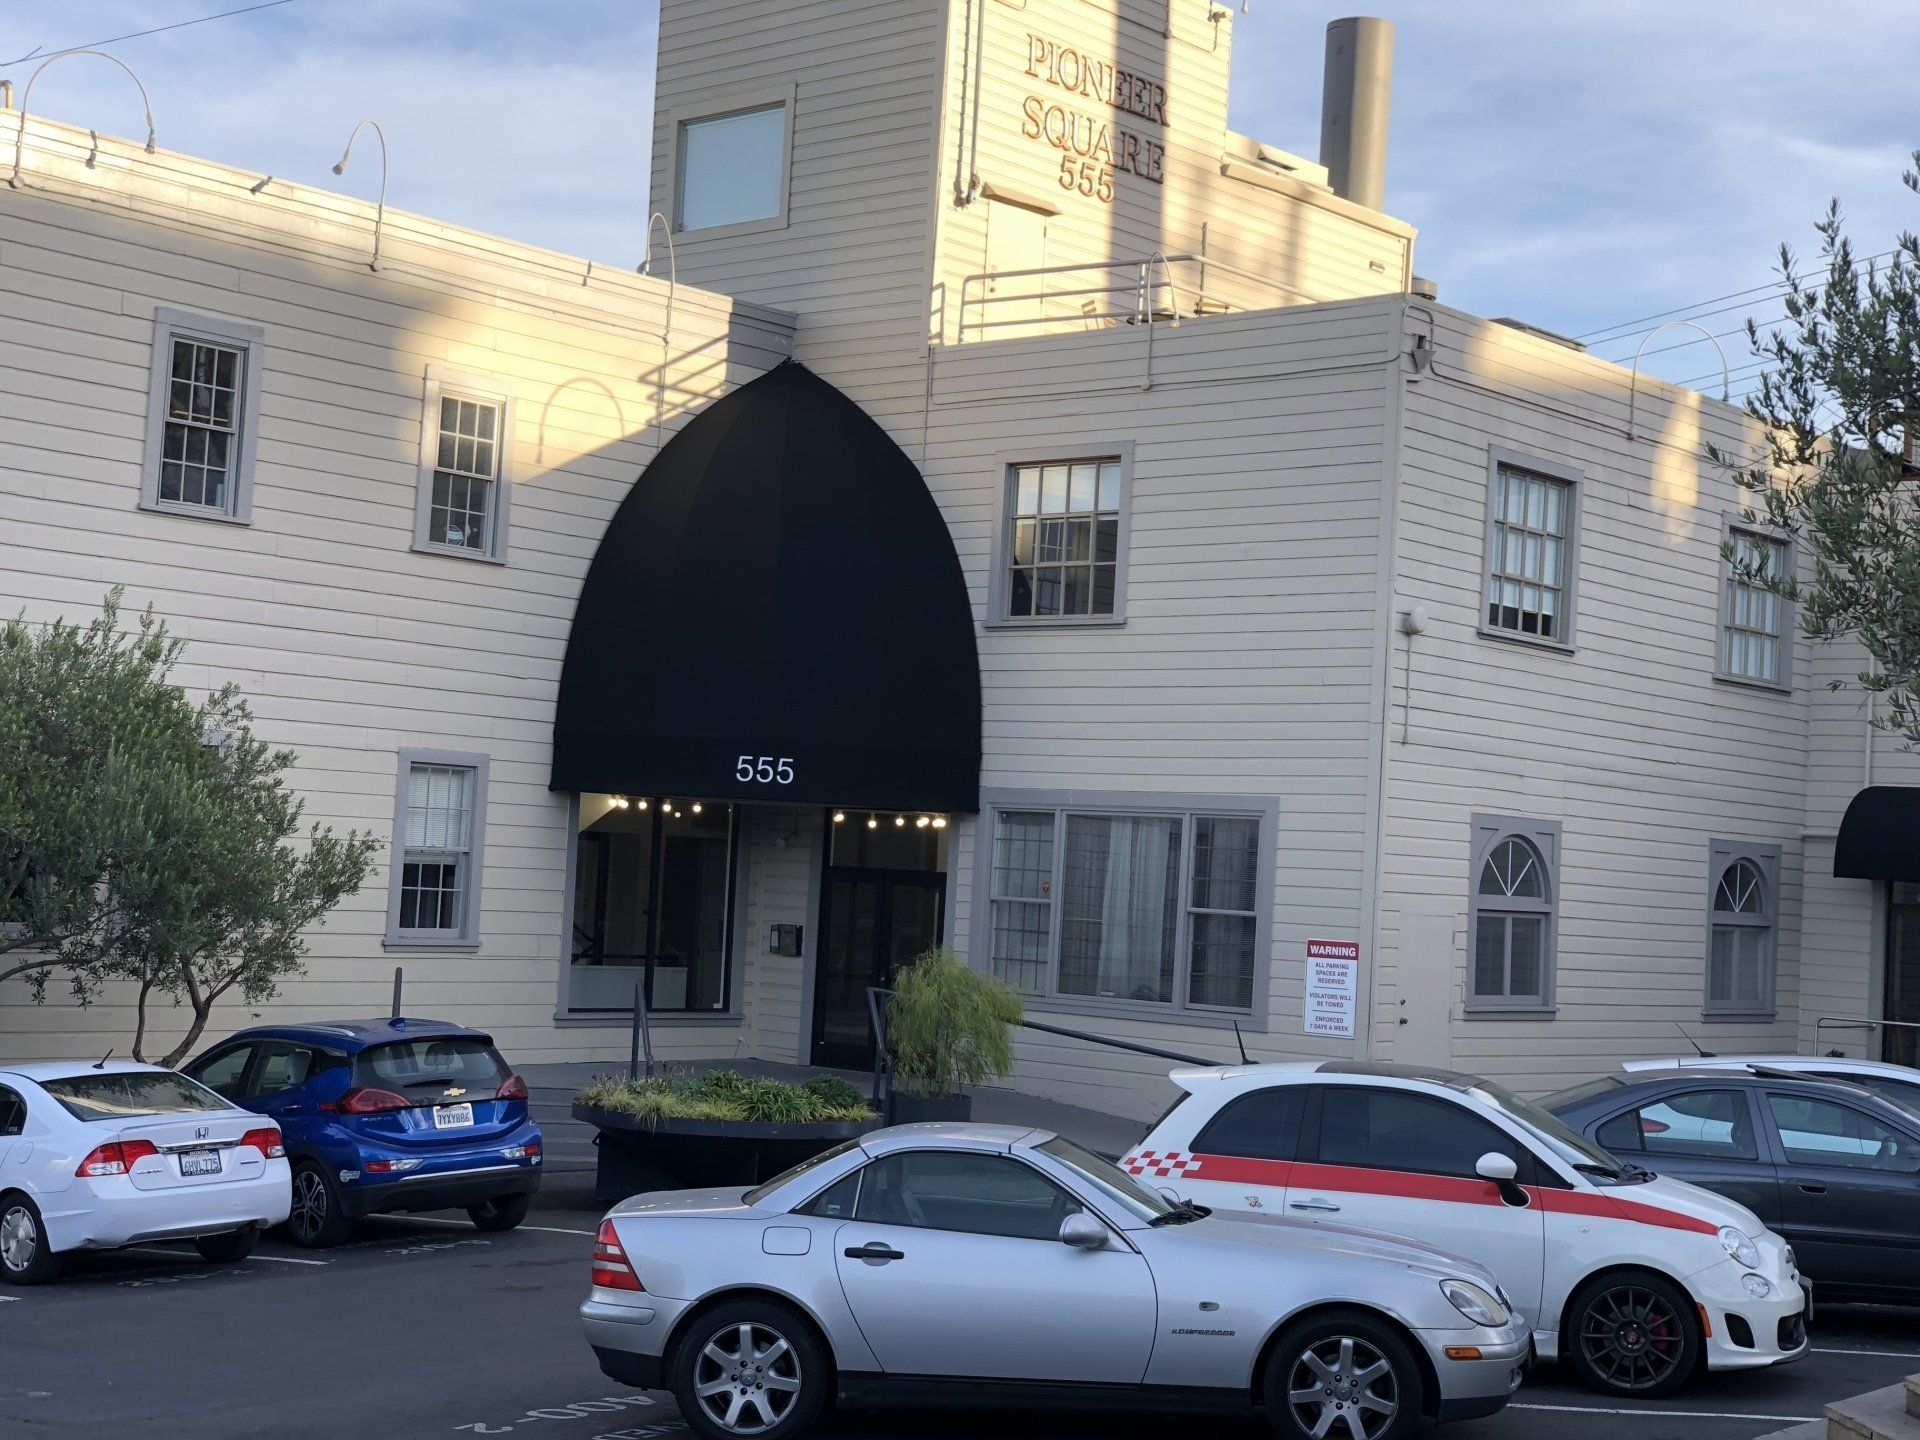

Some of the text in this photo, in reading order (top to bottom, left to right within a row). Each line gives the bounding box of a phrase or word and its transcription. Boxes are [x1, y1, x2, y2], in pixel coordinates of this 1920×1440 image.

[1025, 33, 1170, 127] PIONEER
[1022, 95, 1165, 184] SQUARE
[1059, 154, 1115, 203] 555
[736, 755, 794, 784] 555
[1310, 945, 1356, 957] WARNING
[1326, 962, 1349, 970] PARKING
[1317, 977, 1345, 985] RESERVED
[1309, 992, 1338, 1000] VIOLATORS
[1315, 1015, 1344, 1024] ENFORCED
[1314, 1023, 1327, 1031] DAYS
